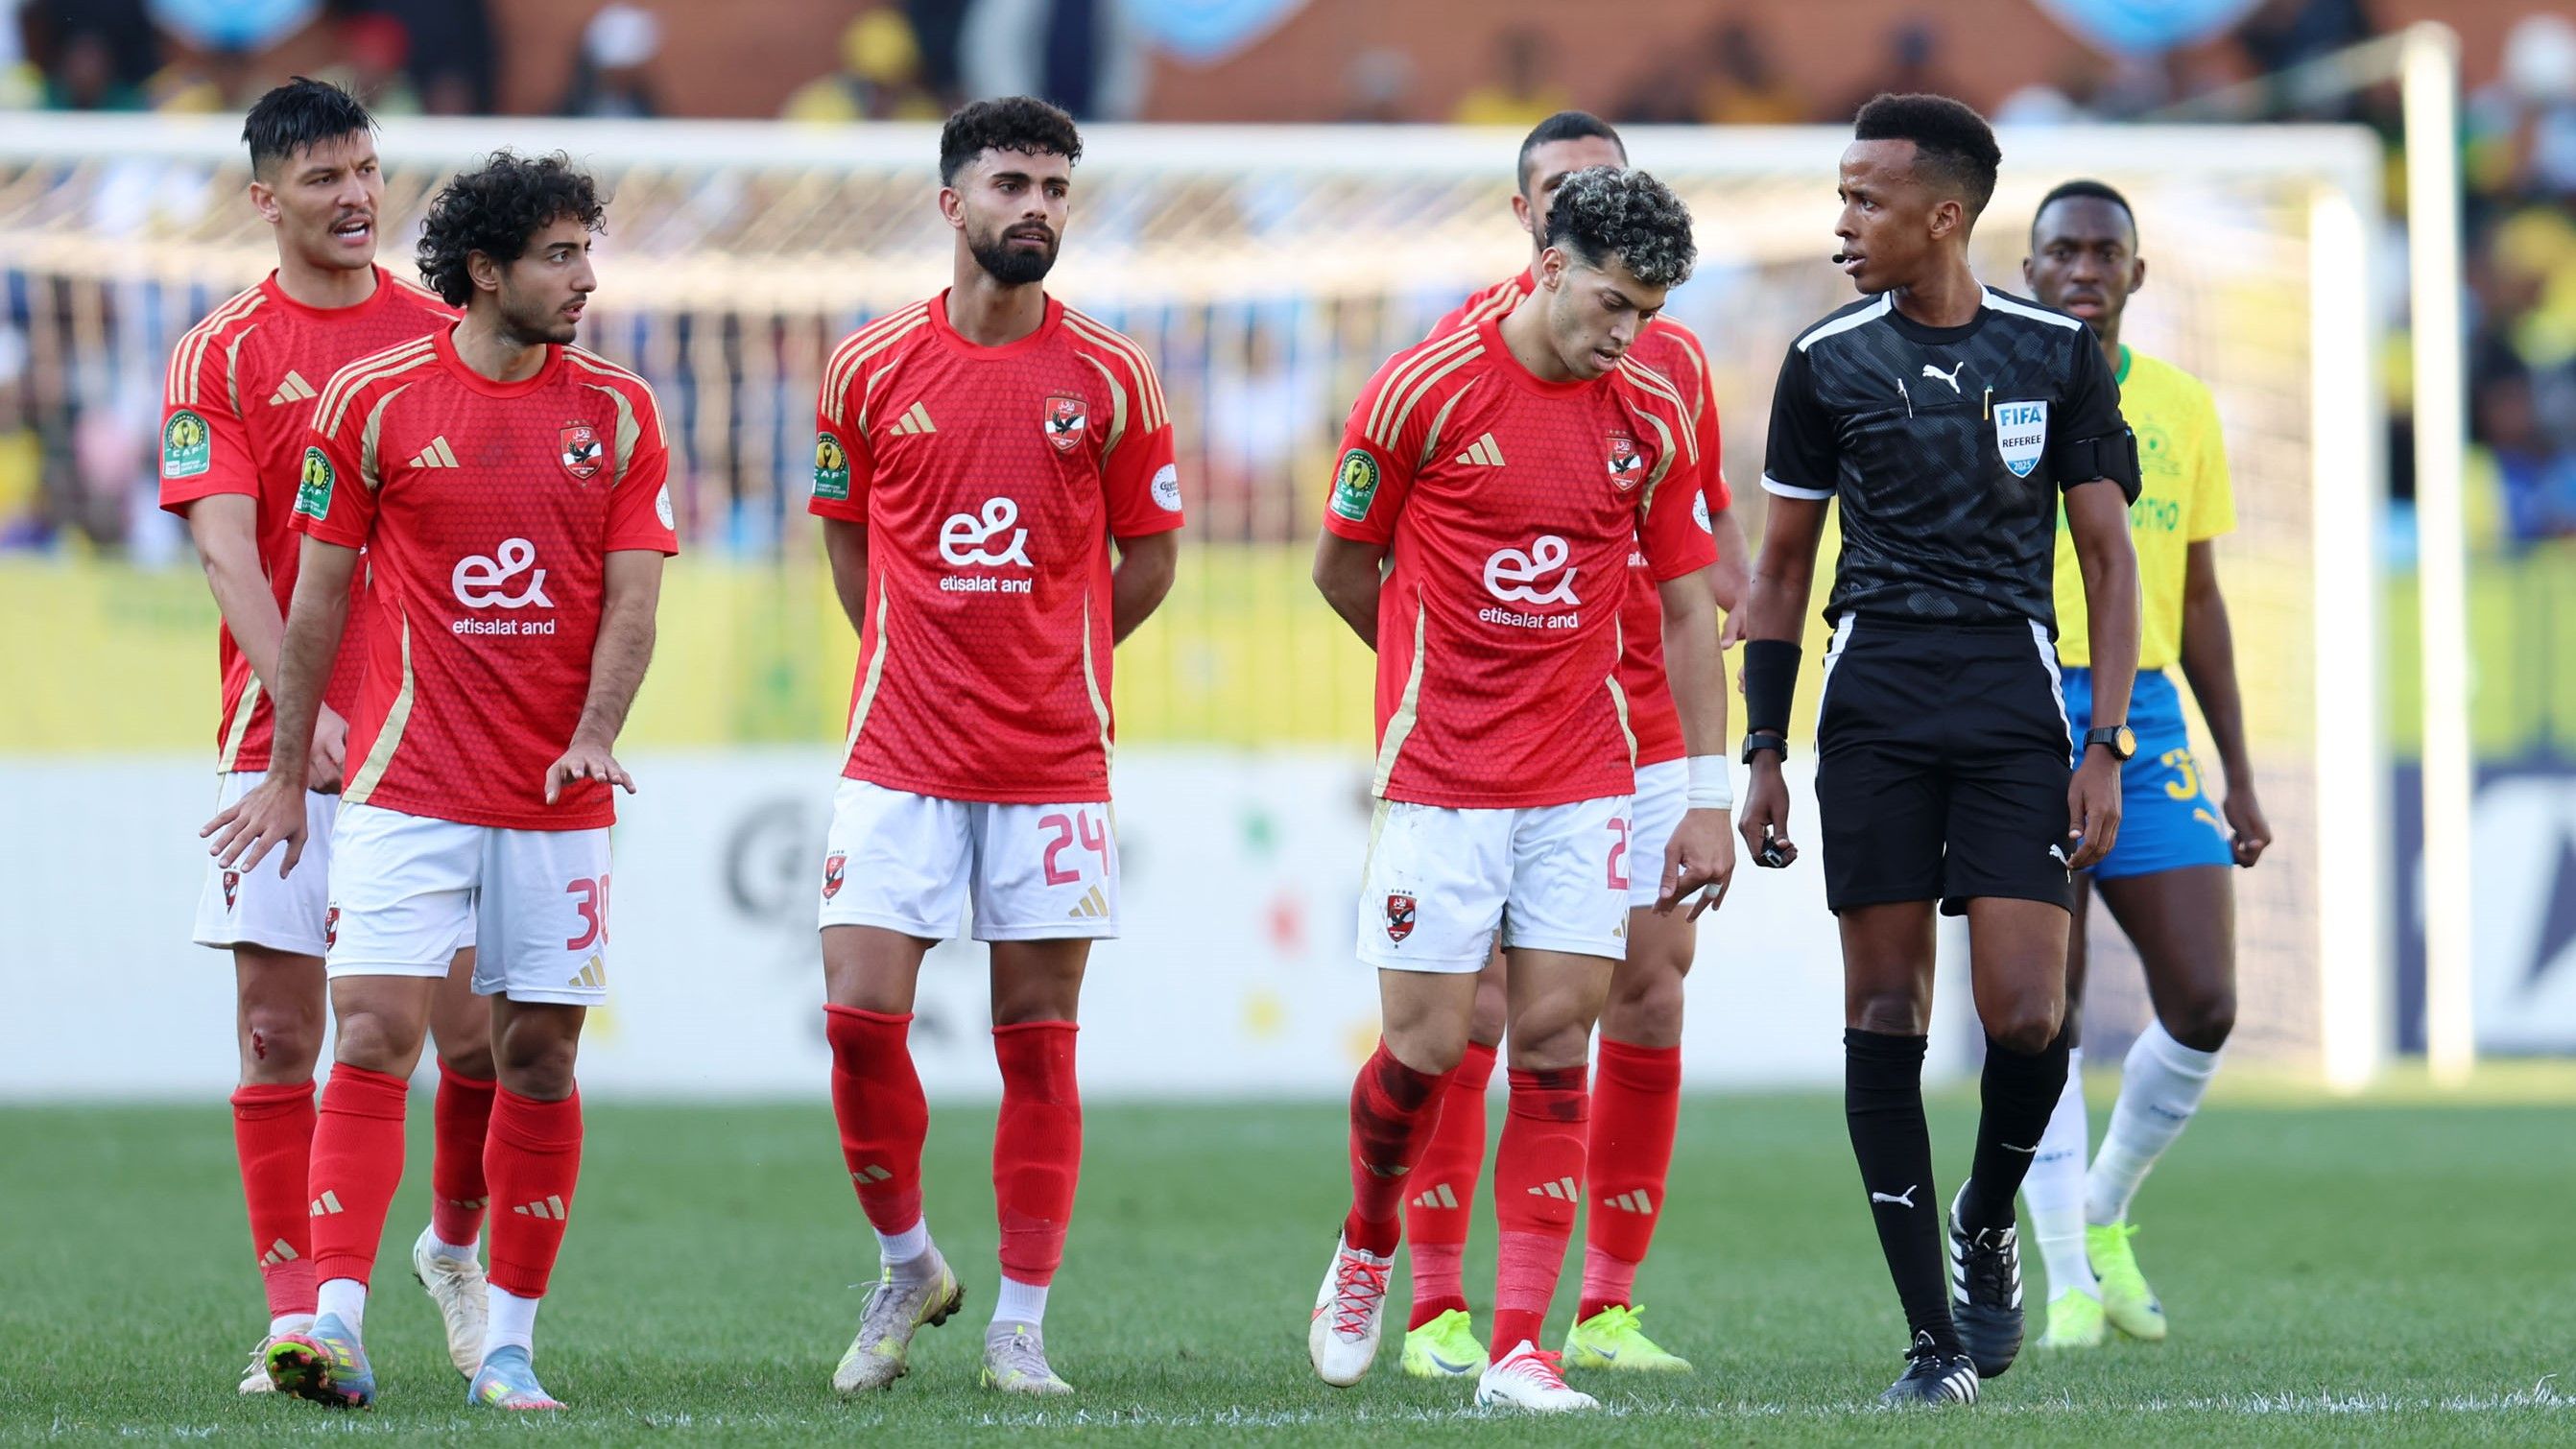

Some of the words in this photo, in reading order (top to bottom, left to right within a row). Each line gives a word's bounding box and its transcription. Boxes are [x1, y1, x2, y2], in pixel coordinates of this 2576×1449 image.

[2000, 406, 2042, 426] FIFA
[2002, 435, 2041, 448] REFEREE
[173, 446, 199, 458] CAF
[2014, 460, 2032, 471] 2025
[940, 575, 997, 592] etisalat
[1000, 577, 1033, 593] and
[452, 617, 517, 634] etisalat
[521, 618, 555, 634] and
[1478, 606, 1543, 629] etisalat
[1546, 611, 1579, 629] and
[1038, 809, 1108, 887] 24
[1606, 818, 1632, 891] 2
[565, 873, 609, 951] 30
